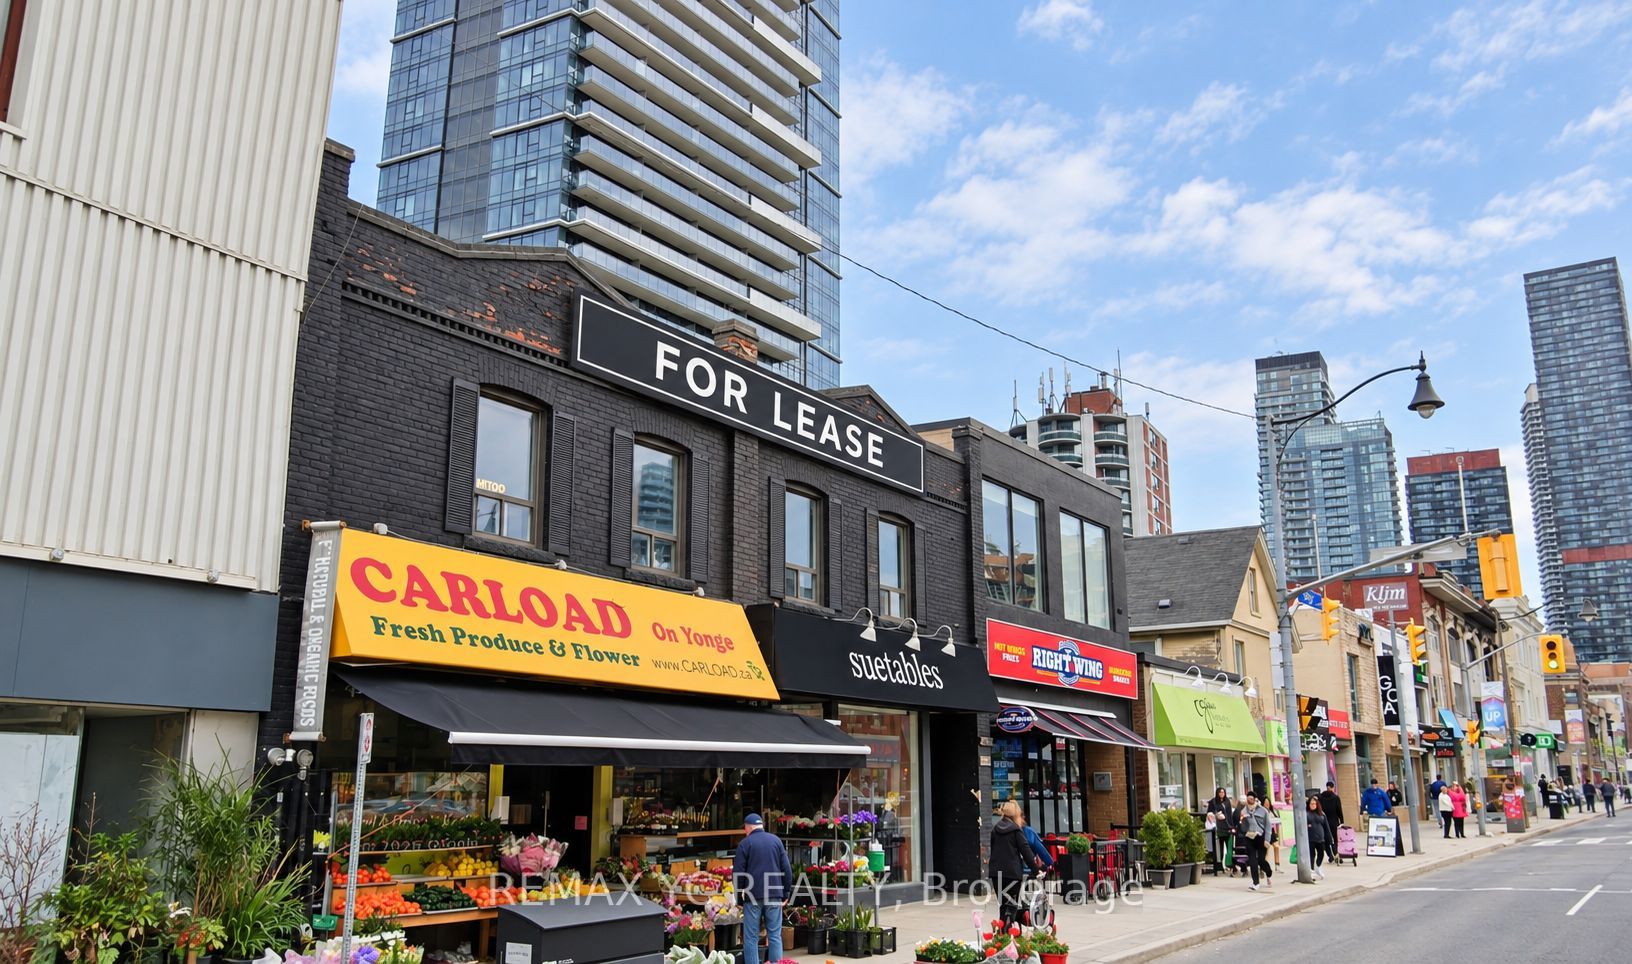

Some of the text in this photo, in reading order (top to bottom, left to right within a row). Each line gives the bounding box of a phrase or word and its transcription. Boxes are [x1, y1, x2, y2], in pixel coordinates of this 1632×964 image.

[655, 340, 884, 468] FOR LEASE
[350, 557, 632, 639] CARLOAD
[370, 615, 640, 667] Fresh Produce & Flower
[651, 622, 735, 654] On Yonge
[849, 651, 944, 690] suetables
[1032, 647, 1072, 673] RIGHT
[1072, 655, 1103, 680] WING
